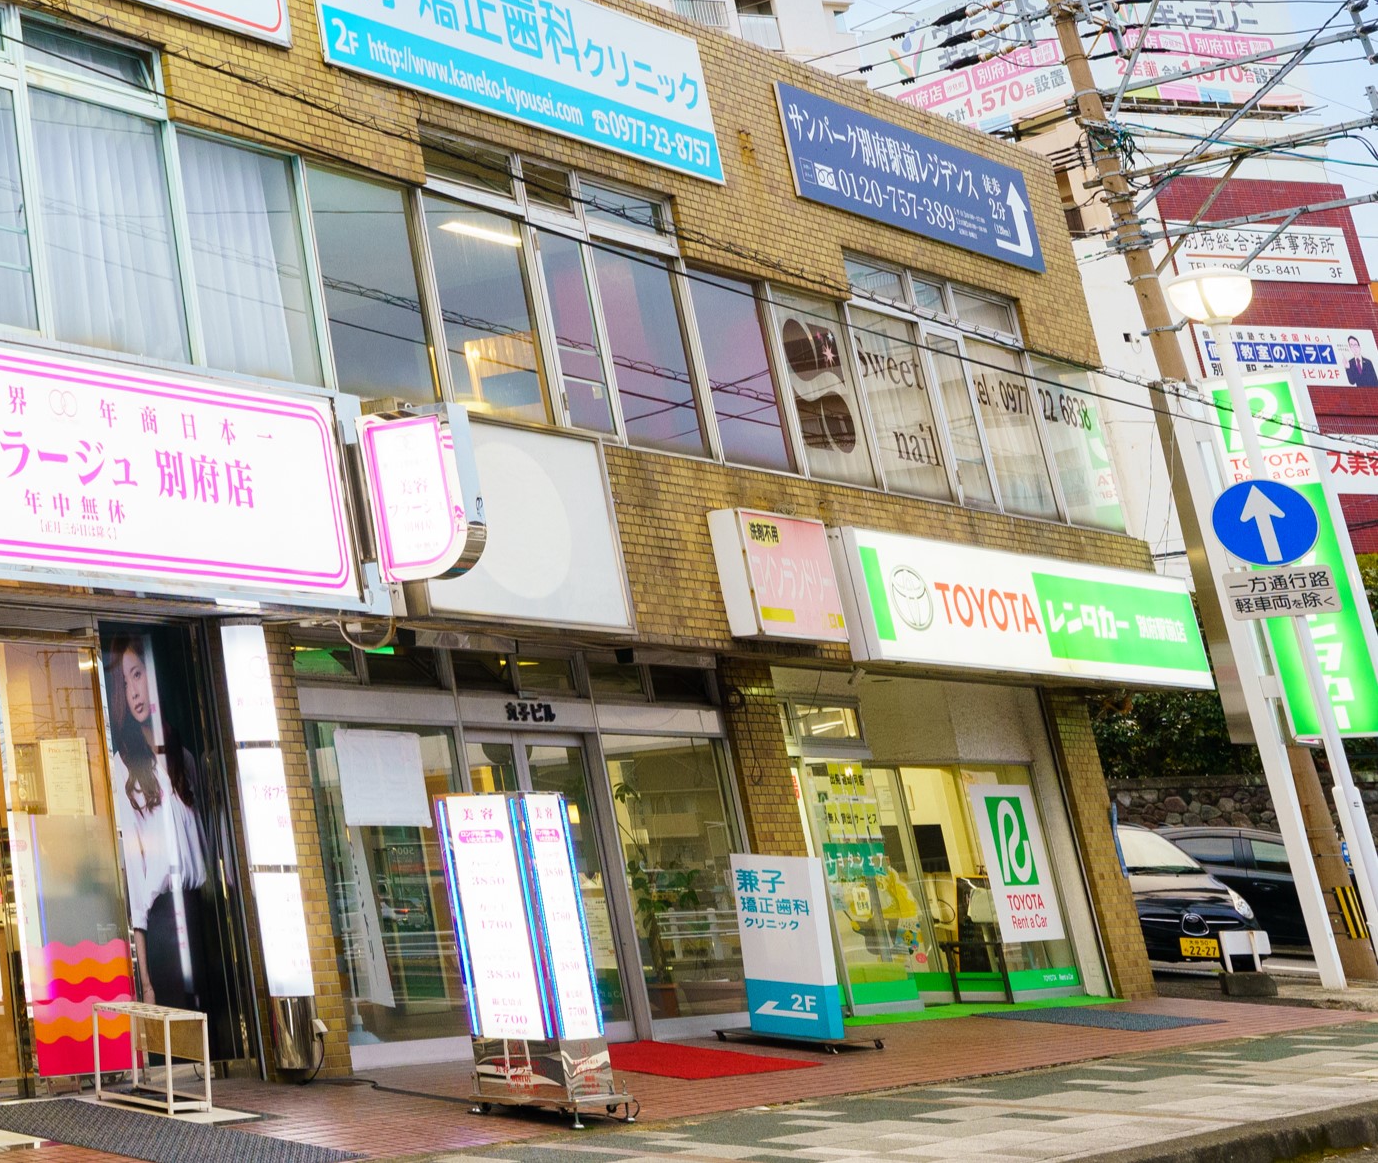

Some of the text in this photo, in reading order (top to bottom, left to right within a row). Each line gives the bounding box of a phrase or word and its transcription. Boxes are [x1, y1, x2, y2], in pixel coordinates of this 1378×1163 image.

[331, 17, 360, 56] 2F
[367, 32, 584, 127] http://www.kaneko-kyousei.com
[838, 168, 956, 232] 0120-757-389
[1329, 267, 1343, 278] 3F
[894, 423, 944, 467] nail
[1229, 451, 1309, 471] TOOTA
[1284, 467, 1310, 478] Car
[155, 448, 256, 512] 別府店
[24, 488, 126, 525] 年中無休
[1229, 569, 1331, 594] 一方通行路
[934, 581, 1043, 635] TOYOTA
[1234, 592, 1336, 615] 軽車両を除く
[1045, 599, 1130, 640] レンタカー
[735, 869, 785, 894] 兼子
[740, 896, 810, 916] 矯正歯科
[1007, 894, 1045, 911] TOYOTA
[744, 917, 799, 931] クリニック
[1012, 915, 1029, 929] Rent
[1035, 914, 1048, 928] Car
[1189, 945, 1217, 956] 22-27
[790, 993, 817, 1012] 2F
